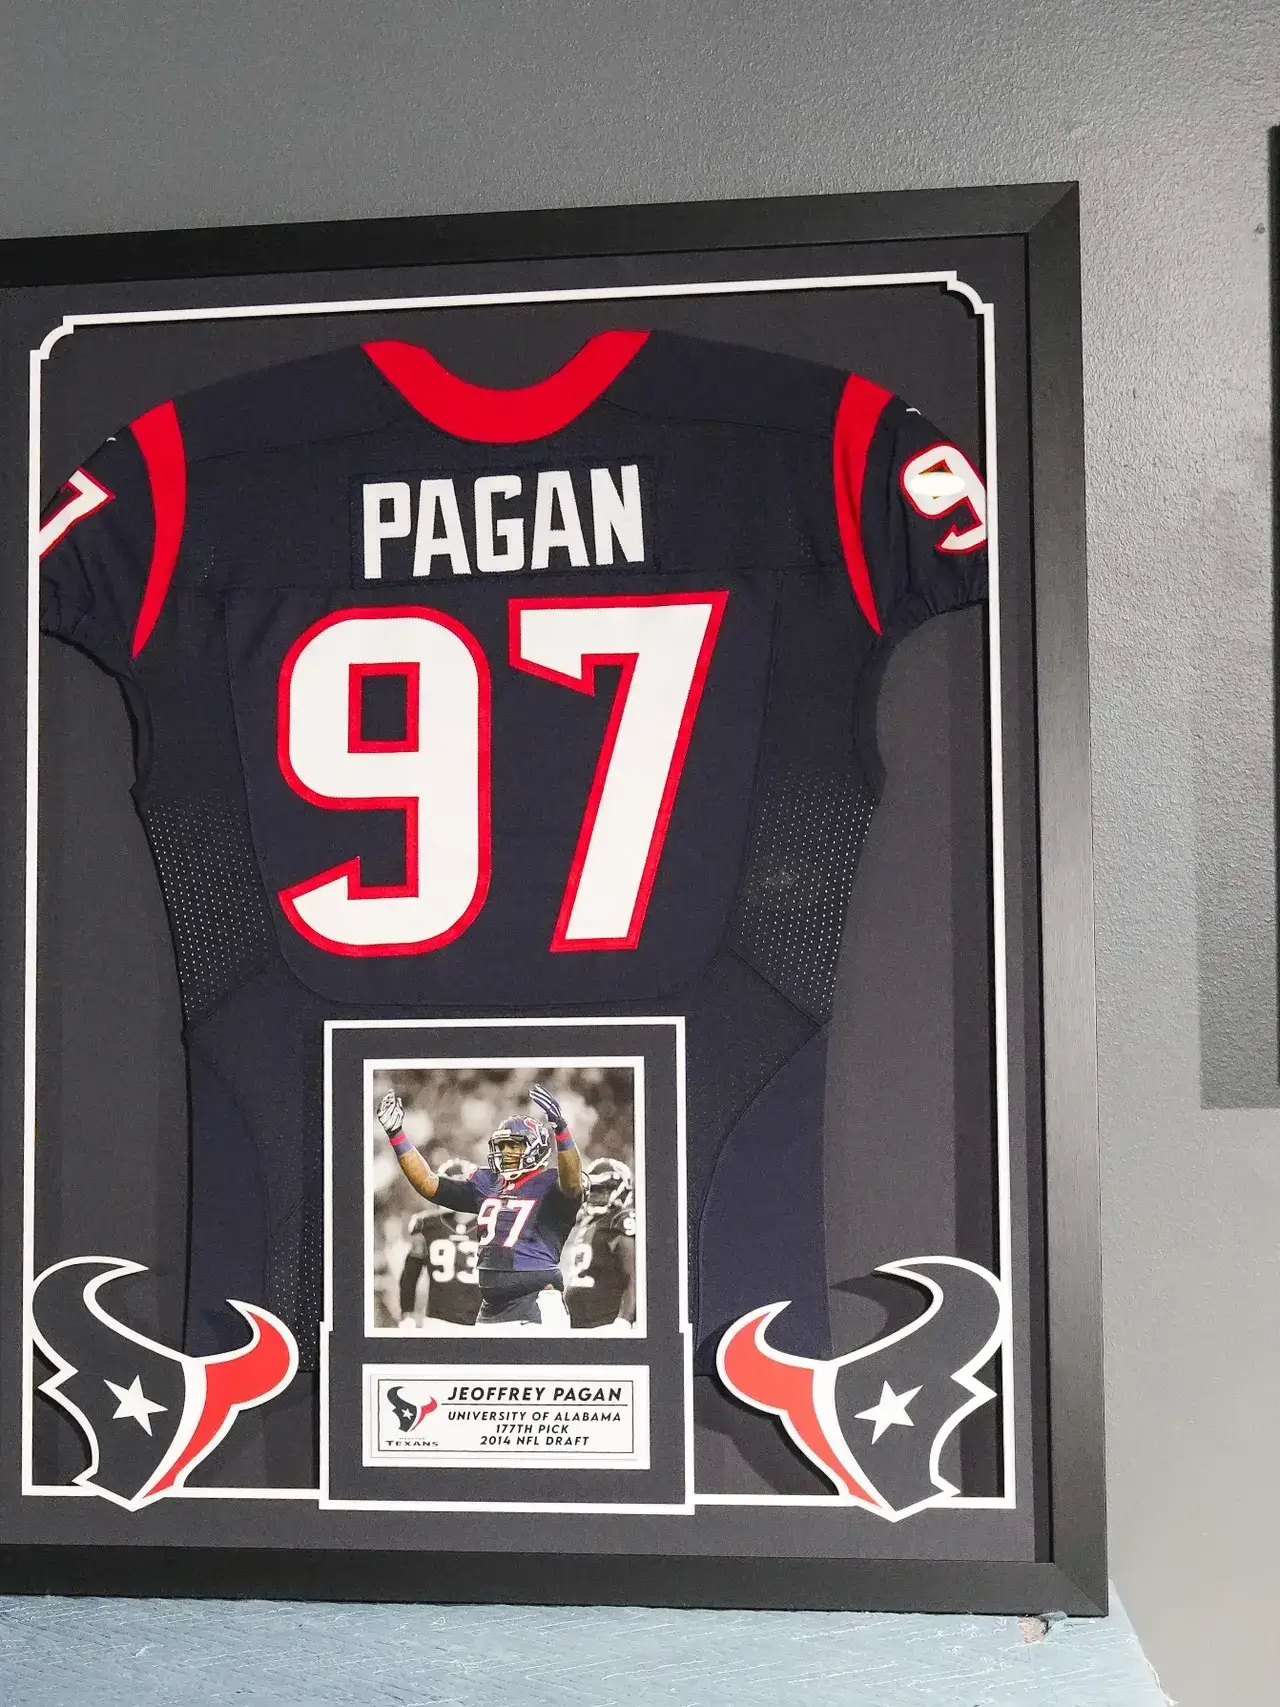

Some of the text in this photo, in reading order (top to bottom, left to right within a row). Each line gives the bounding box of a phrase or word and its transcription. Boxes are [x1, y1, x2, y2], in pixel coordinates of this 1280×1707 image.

[39, 466, 116, 562] 7
[361, 463, 645, 580] PAGAN
[899, 442, 988, 553] 9
[276, 590, 729, 957] 97
[476, 1197, 538, 1248] 97
[429, 1238, 479, 1284] 93
[447, 1386, 622, 1402] JEOFFREY PAGAN
[447, 1411, 622, 1422] UNIVERSITY OF ALABAMA
[480, 1436, 590, 1446] 2014 NFL DRAFT
[496, 1424, 569, 1434] 177TH PICK
